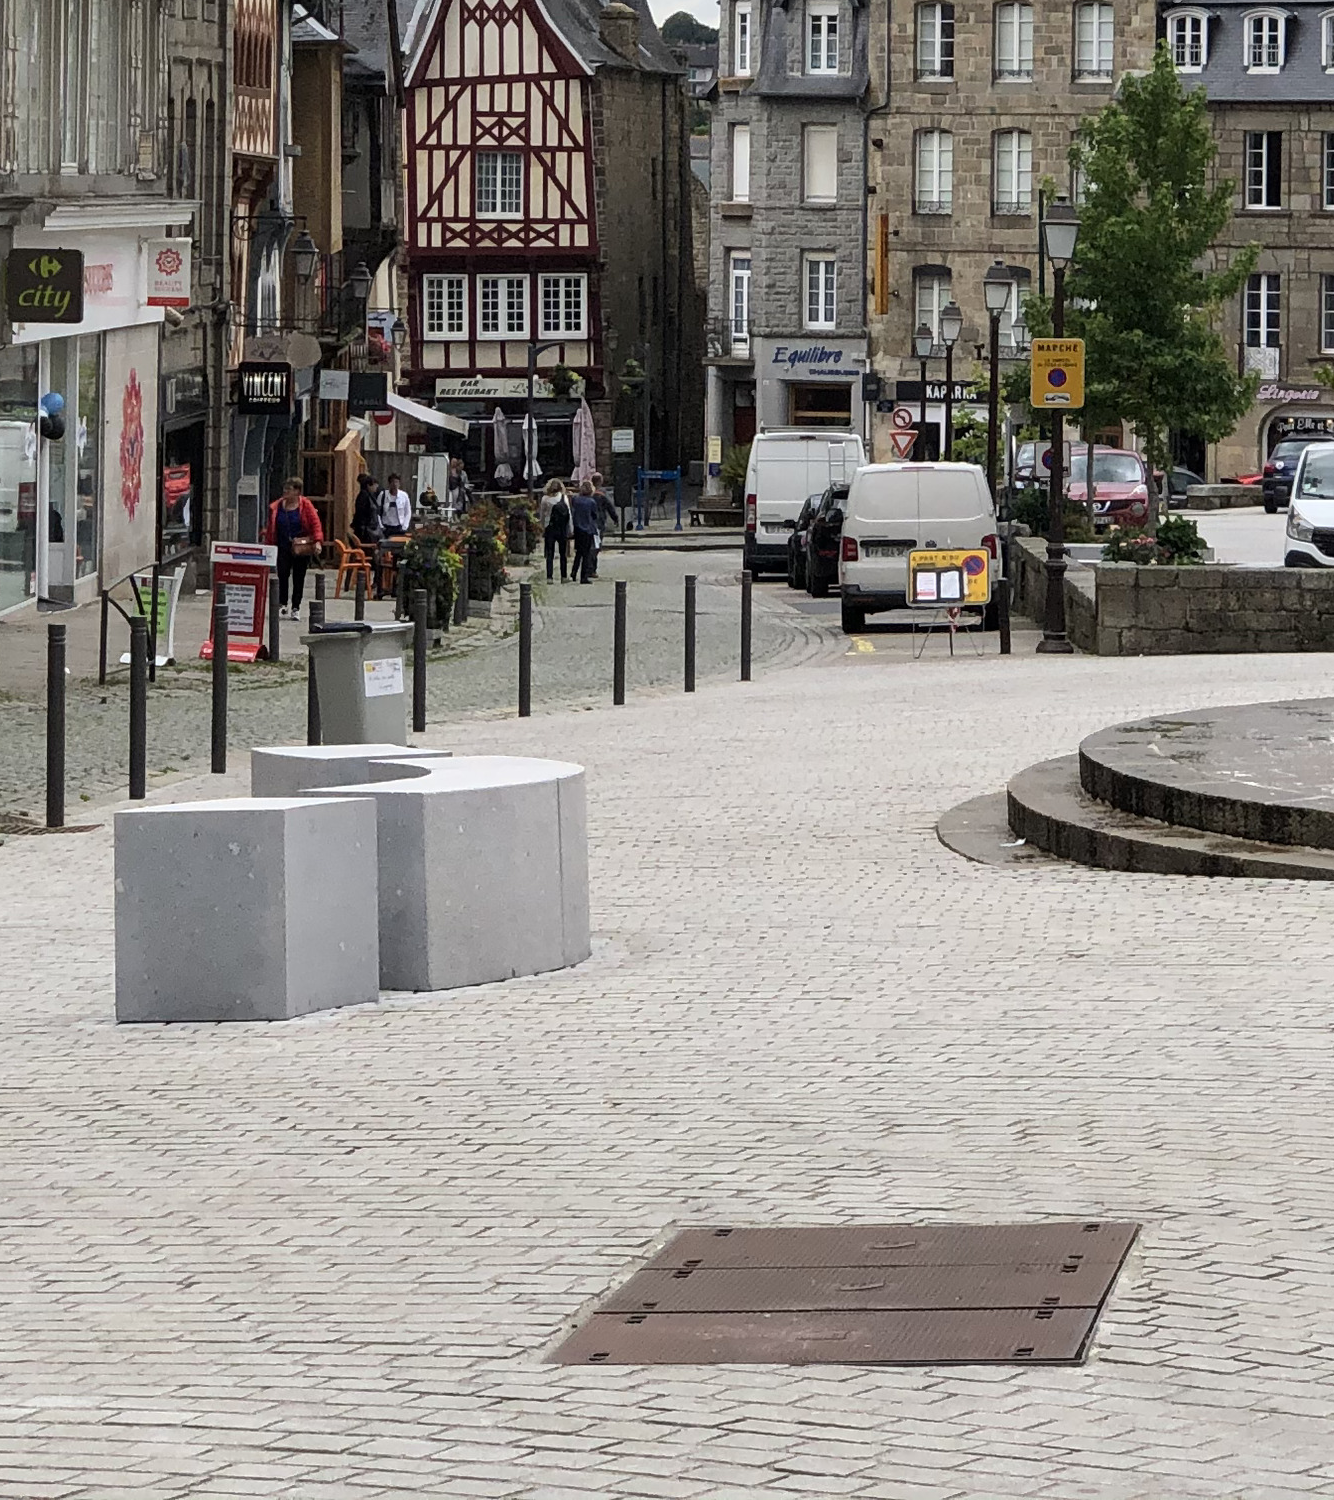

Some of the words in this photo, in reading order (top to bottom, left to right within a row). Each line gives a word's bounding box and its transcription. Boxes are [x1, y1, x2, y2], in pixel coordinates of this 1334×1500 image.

[18, 284, 71, 318] city
[771, 346, 843, 368] Equilibre
[439, 388, 499, 396] RESTAURANT
[925, 384, 977, 400] KAPRKA
